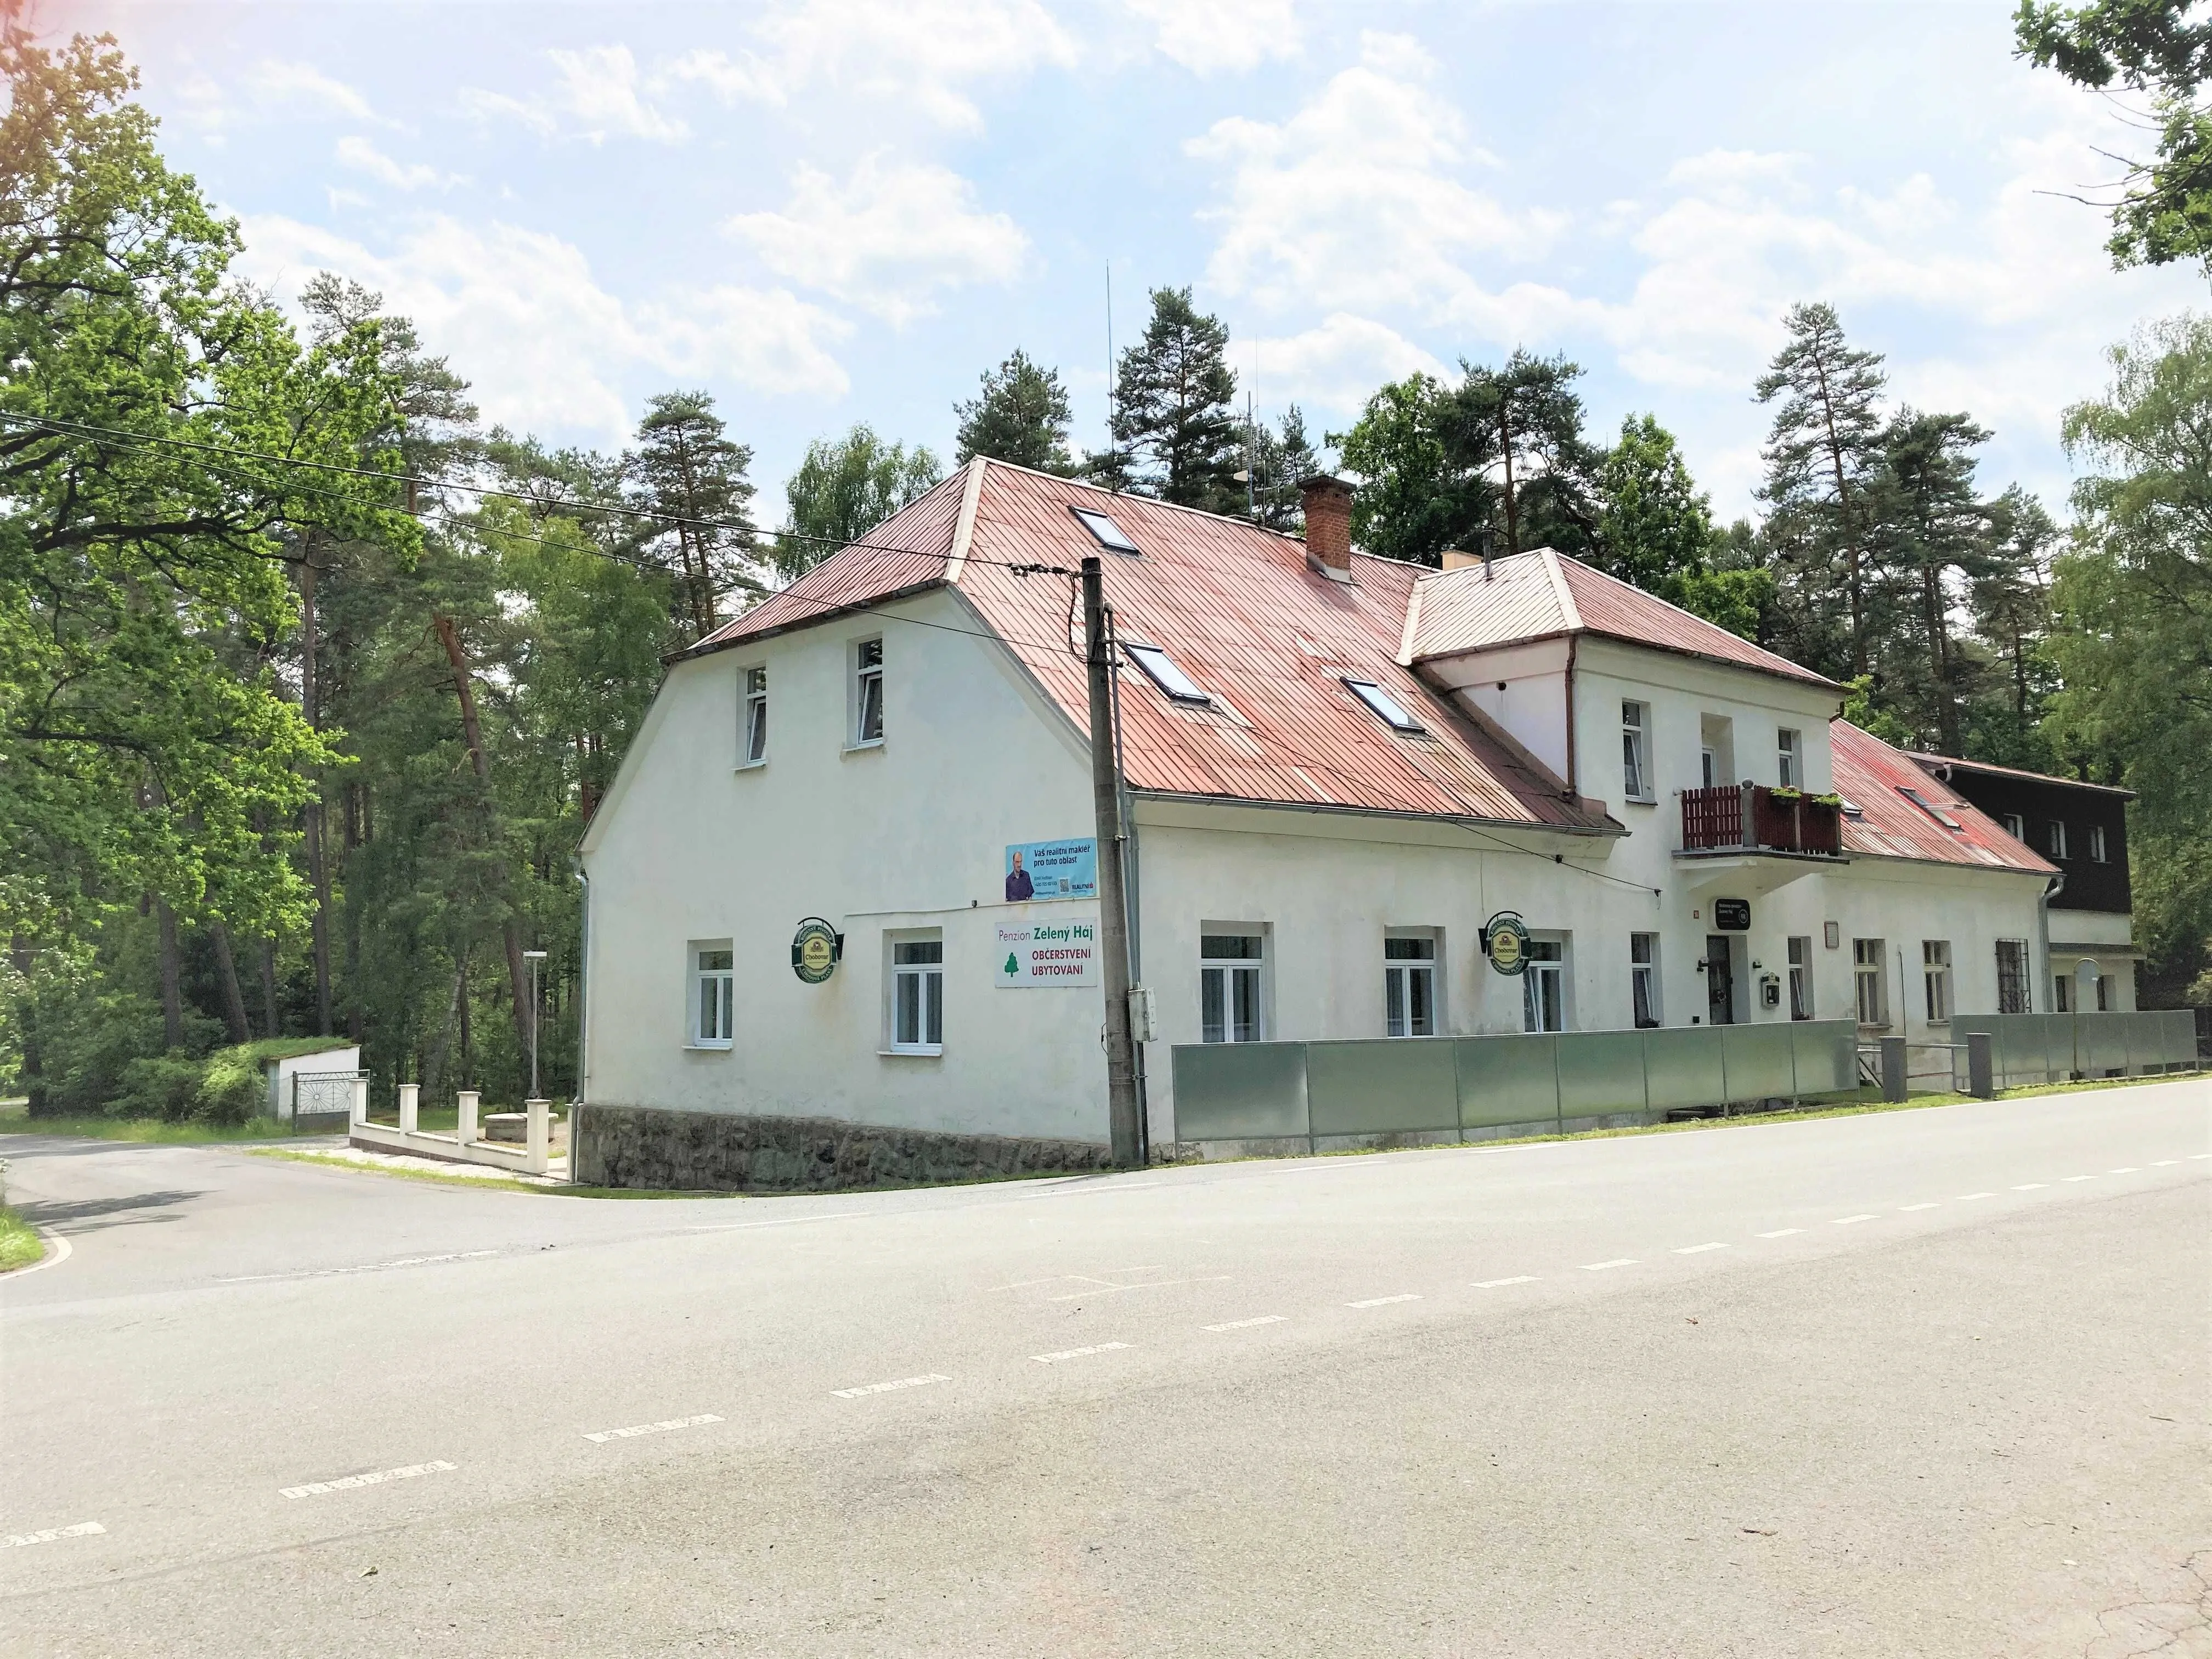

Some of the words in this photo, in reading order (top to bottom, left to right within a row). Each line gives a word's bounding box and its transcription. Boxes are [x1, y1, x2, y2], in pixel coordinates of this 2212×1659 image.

[1034, 860, 1045, 868] pro
[1059, 856, 1077, 865] oblast
[999, 930, 1030, 941] Penzion
[1034, 926, 1070, 942] Zelený
[1074, 924, 1093, 941] Háj
[1032, 945, 1091, 960] OBČERSTVENÍ
[1032, 962, 1084, 975] UBYTOVÁNÍ
